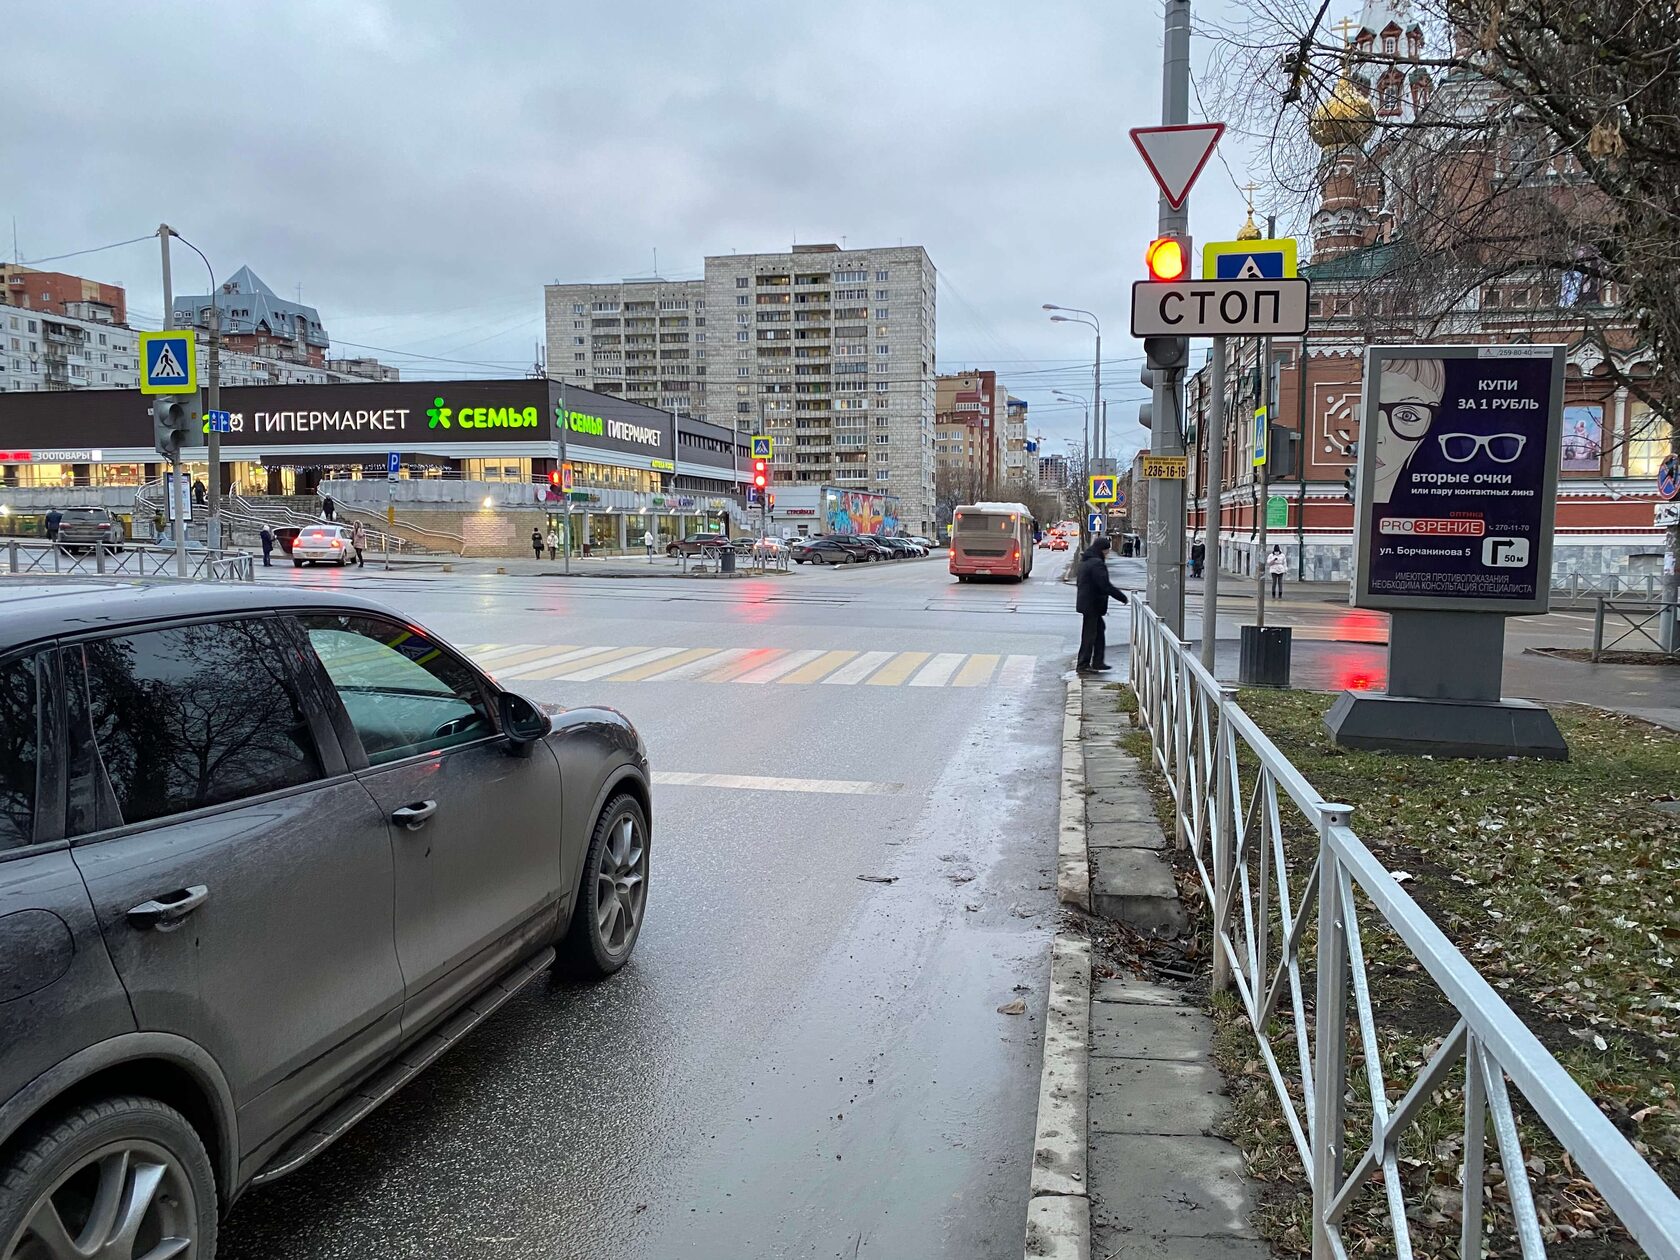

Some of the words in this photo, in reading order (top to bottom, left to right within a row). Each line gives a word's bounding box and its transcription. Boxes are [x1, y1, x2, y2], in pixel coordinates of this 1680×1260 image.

[1159, 290, 1281, 325] СТОП
[1478, 379, 1518, 391] КУПИ
[1457, 398, 1476, 410] ЗА
[1480, 398, 1488, 410] 1
[1492, 399, 1540, 410] РУБЛЬ
[254, 409, 411, 432] ГИПЕРМАРКЕТ
[458, 406, 538, 429] СЕМЬЯ
[569, 411, 603, 436] СЕМЬЯ
[607, 419, 662, 447] ГИПЕРМАРКЕТ
[37, 451, 90, 460] ЗООТОВАРЫ
[1411, 473, 1470, 485] вторые
[1473, 474, 1512, 484] очки
[1430, 488, 1453, 497] пару
[1454, 488, 1510, 496] контактных
[1379, 547, 1394, 556] ул.
[1397, 546, 1463, 557] Борчанинова
[1464, 548, 1471, 556] 5
[1504, 554, 1516, 563] 50
[1395, 571, 1431, 581] ИМЕЮТСЯ
[1432, 573, 1510, 583] ПРОТИВОПОКАЗАНИЯ
[1372, 579, 1420, 590] НЕОБХОДИМА
[1421, 581, 1477, 591] КОНСУЛЬТАЦИЯ
[1478, 582, 1533, 593] СПЕЦИАЛИСТА
